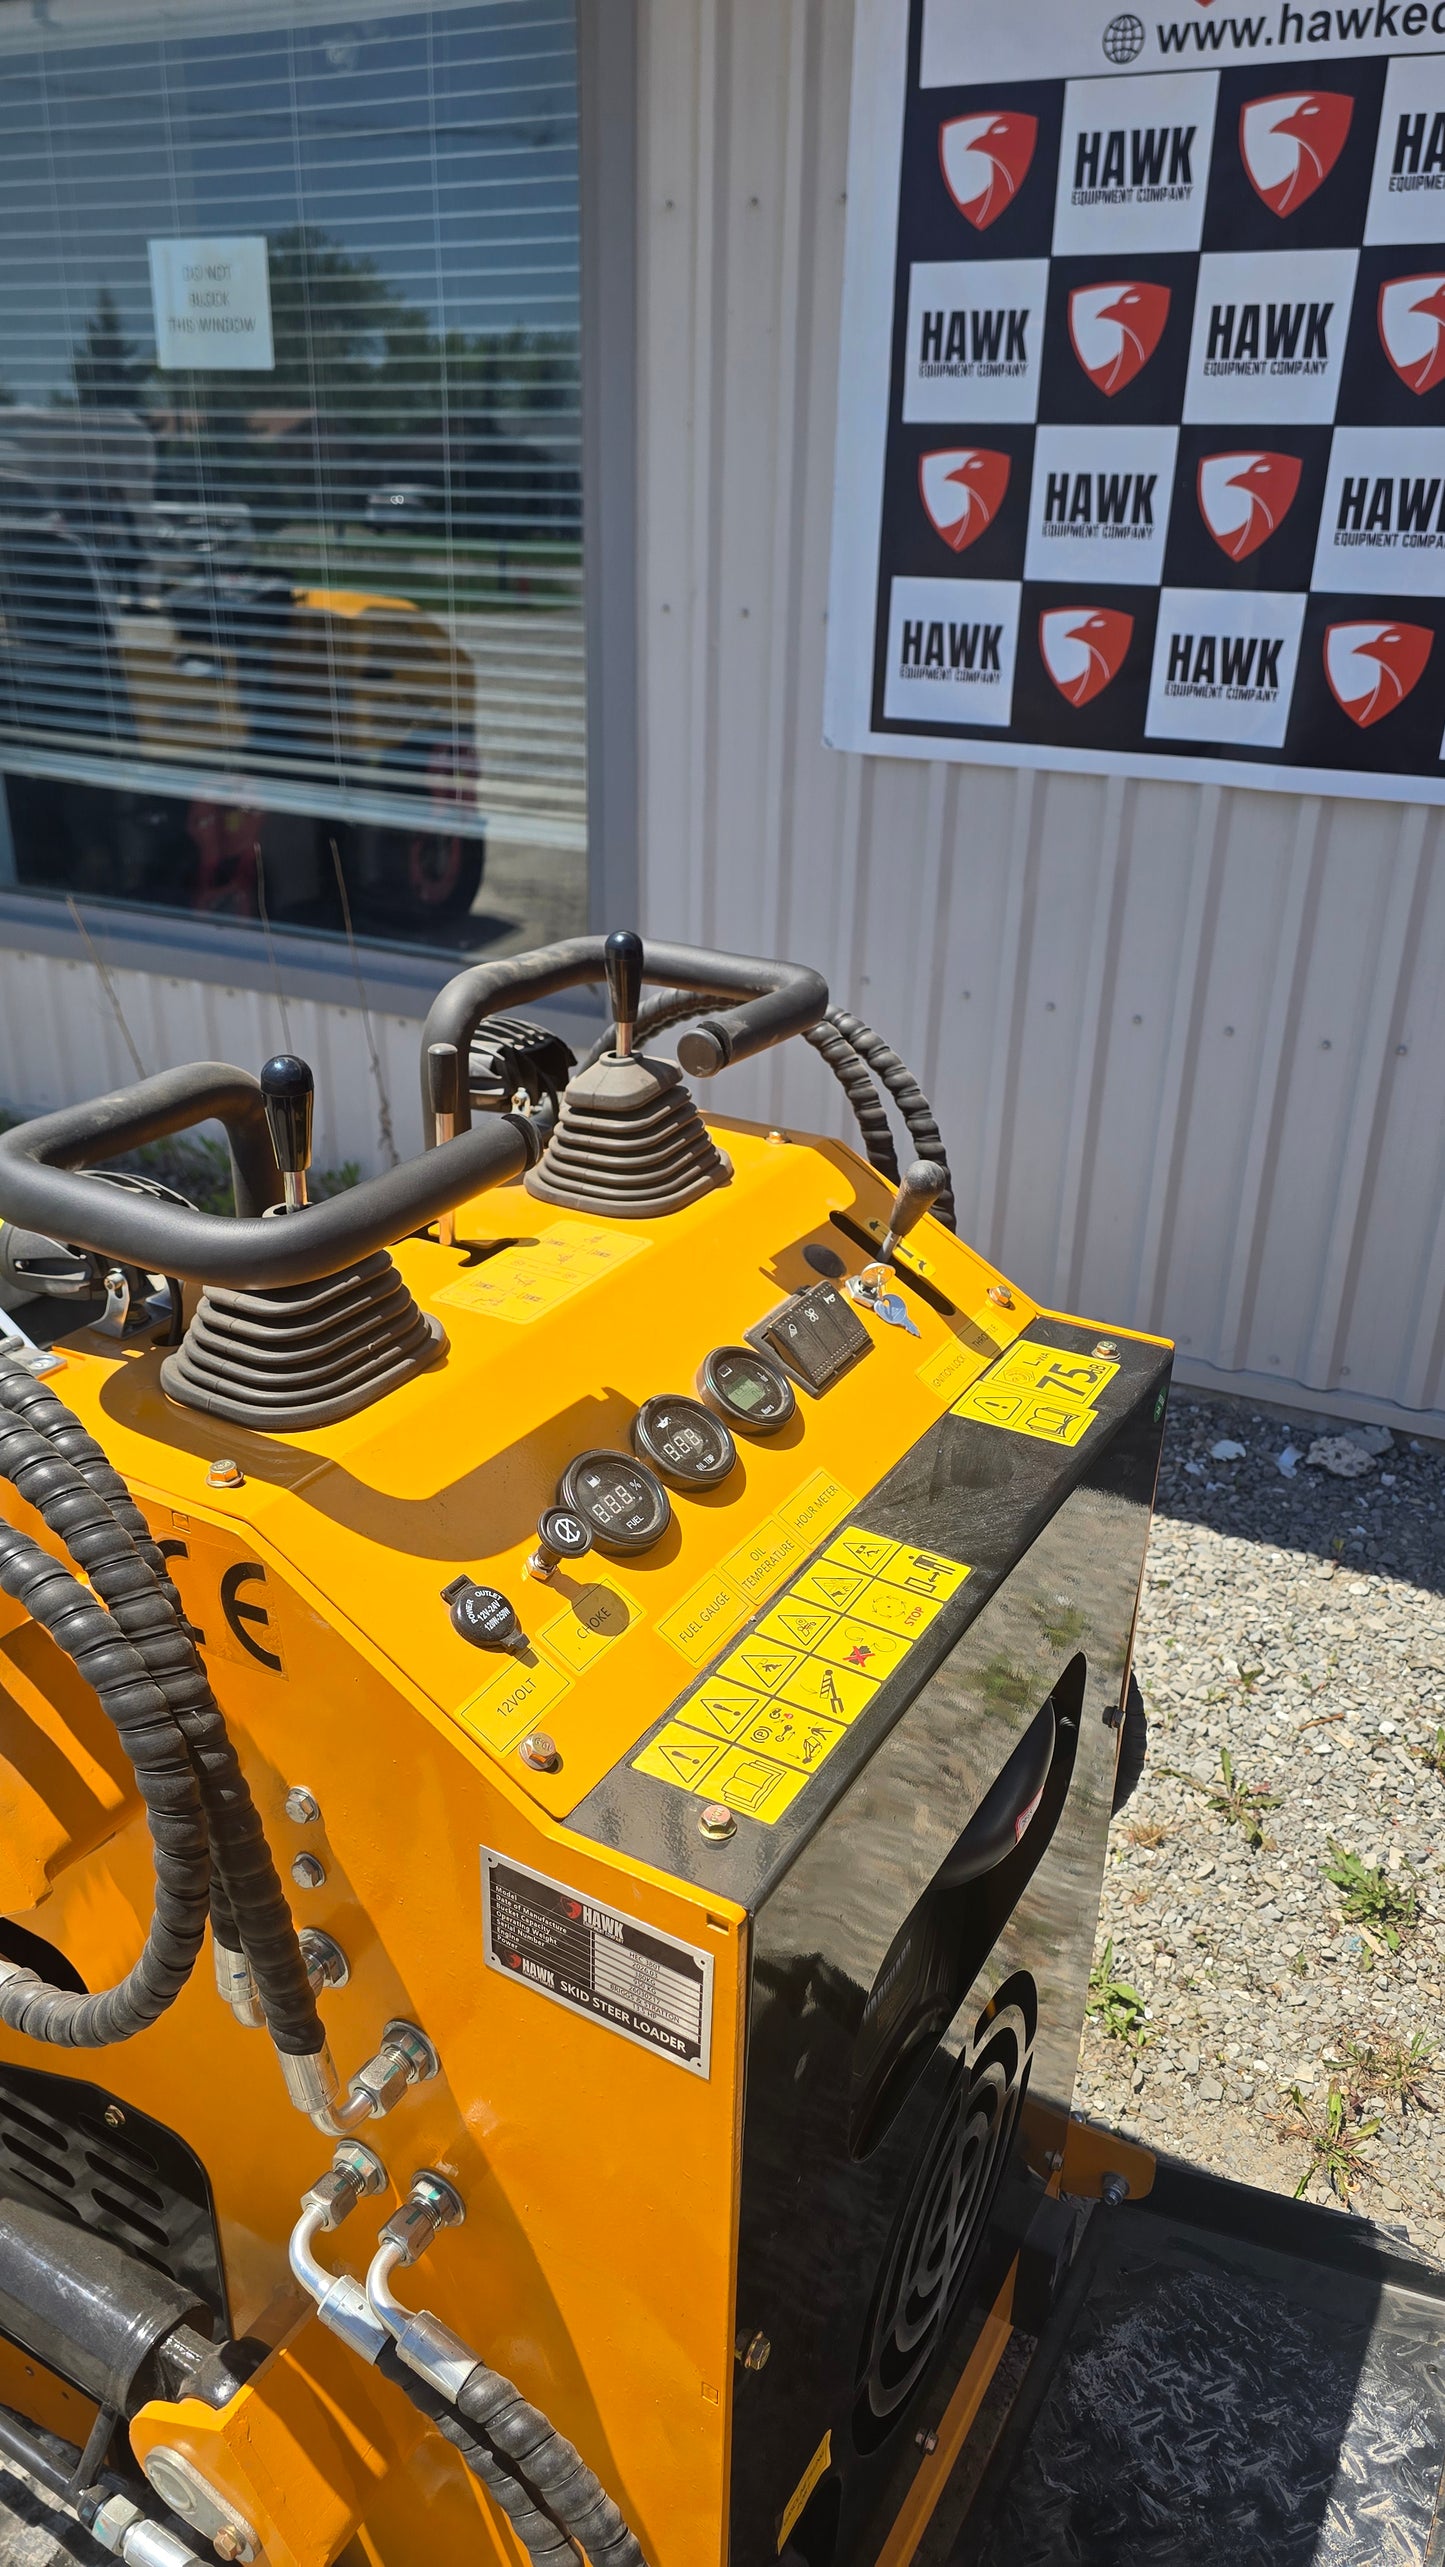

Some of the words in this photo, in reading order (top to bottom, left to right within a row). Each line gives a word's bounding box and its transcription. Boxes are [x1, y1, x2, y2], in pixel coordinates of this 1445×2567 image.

[1074, 126, 1198, 189] HAWK
[1071, 189, 1134, 206] EQUIPMENT
[1136, 186, 1194, 203] COMPANY
[1388, 174, 1445, 193] EQUIPME
[204, 264, 232, 281] NOT
[198, 317, 257, 333] WINDOW
[920, 309, 1031, 362] HAWK
[1206, 302, 1335, 359] HAWK
[919, 363, 974, 378] EQUIPMENT
[977, 363, 1029, 378] COMPANY
[1203, 360, 1267, 377] EQUIPMENT
[1270, 360, 1328, 376] COMPANY
[1044, 473, 1158, 524] HAWK
[1042, 523, 1099, 538] EQUIPMENT
[1102, 525, 1155, 541] COMPANY
[1334, 533, 1399, 547] EQUIPMENT
[1401, 534, 1445, 549] COMPA
[901, 620, 1003, 670] HAWK
[899, 664, 952, 681] EQUIPMENT
[954, 669, 1001, 684] COMPANY
[1167, 634, 1284, 688] HAWK
[1164, 682, 1223, 699] EQUIPMENT
[1225, 686, 1279, 702] COMPANY
[971, 1323, 999, 1348] THROTTLE
[949, 1352, 967, 1369] LOCK
[1035, 1362, 1098, 1397] 75
[695, 1462, 707, 1471] OIL
[703, 1453, 715, 1465] TEMP
[794, 1505, 818, 1529] HOUR
[814, 1484, 839, 1509] METER
[626, 1514, 645, 1530] FUEL
[741, 1539, 796, 1591] TEMPERATURE
[749, 1546, 767, 1562] OIL
[465, 1598, 478, 1625] POWER
[474, 1590, 503, 1601] OUTLET
[678, 1620, 703, 1644] FUEL
[699, 1591, 731, 1623] GAUGE
[904, 1606, 925, 1627] STOP
[576, 1606, 612, 1639] CHOKE
[496, 1677, 537, 1717] 12VOLT
[495, 1885, 518, 1901] Model
[495, 1894, 512, 1907] Date
[513, 1903, 521, 1911] of
[522, 1905, 568, 1934] Manufacture
[496, 1902, 520, 1918] Bucket
[520, 1912, 551, 1935] Capacity
[496, 1910, 531, 1933] Operating
[532, 1927, 559, 1946] Weight
[582, 1904, 624, 1940] HAWK
[496, 1918, 516, 1933] Serial
[517, 1930, 545, 1947] Number
[496, 1926, 520, 1942] Engine
[497, 1934, 518, 1950] Power
[522, 1957, 555, 1987] HAWK
[560, 1980, 590, 2002] SKID
[592, 1996, 631, 2025] STEER
[633, 2017, 687, 2053] LOADER
[609, 1982, 635, 2001] BRIGGS
[643, 1999, 680, 2024] STRATTON
